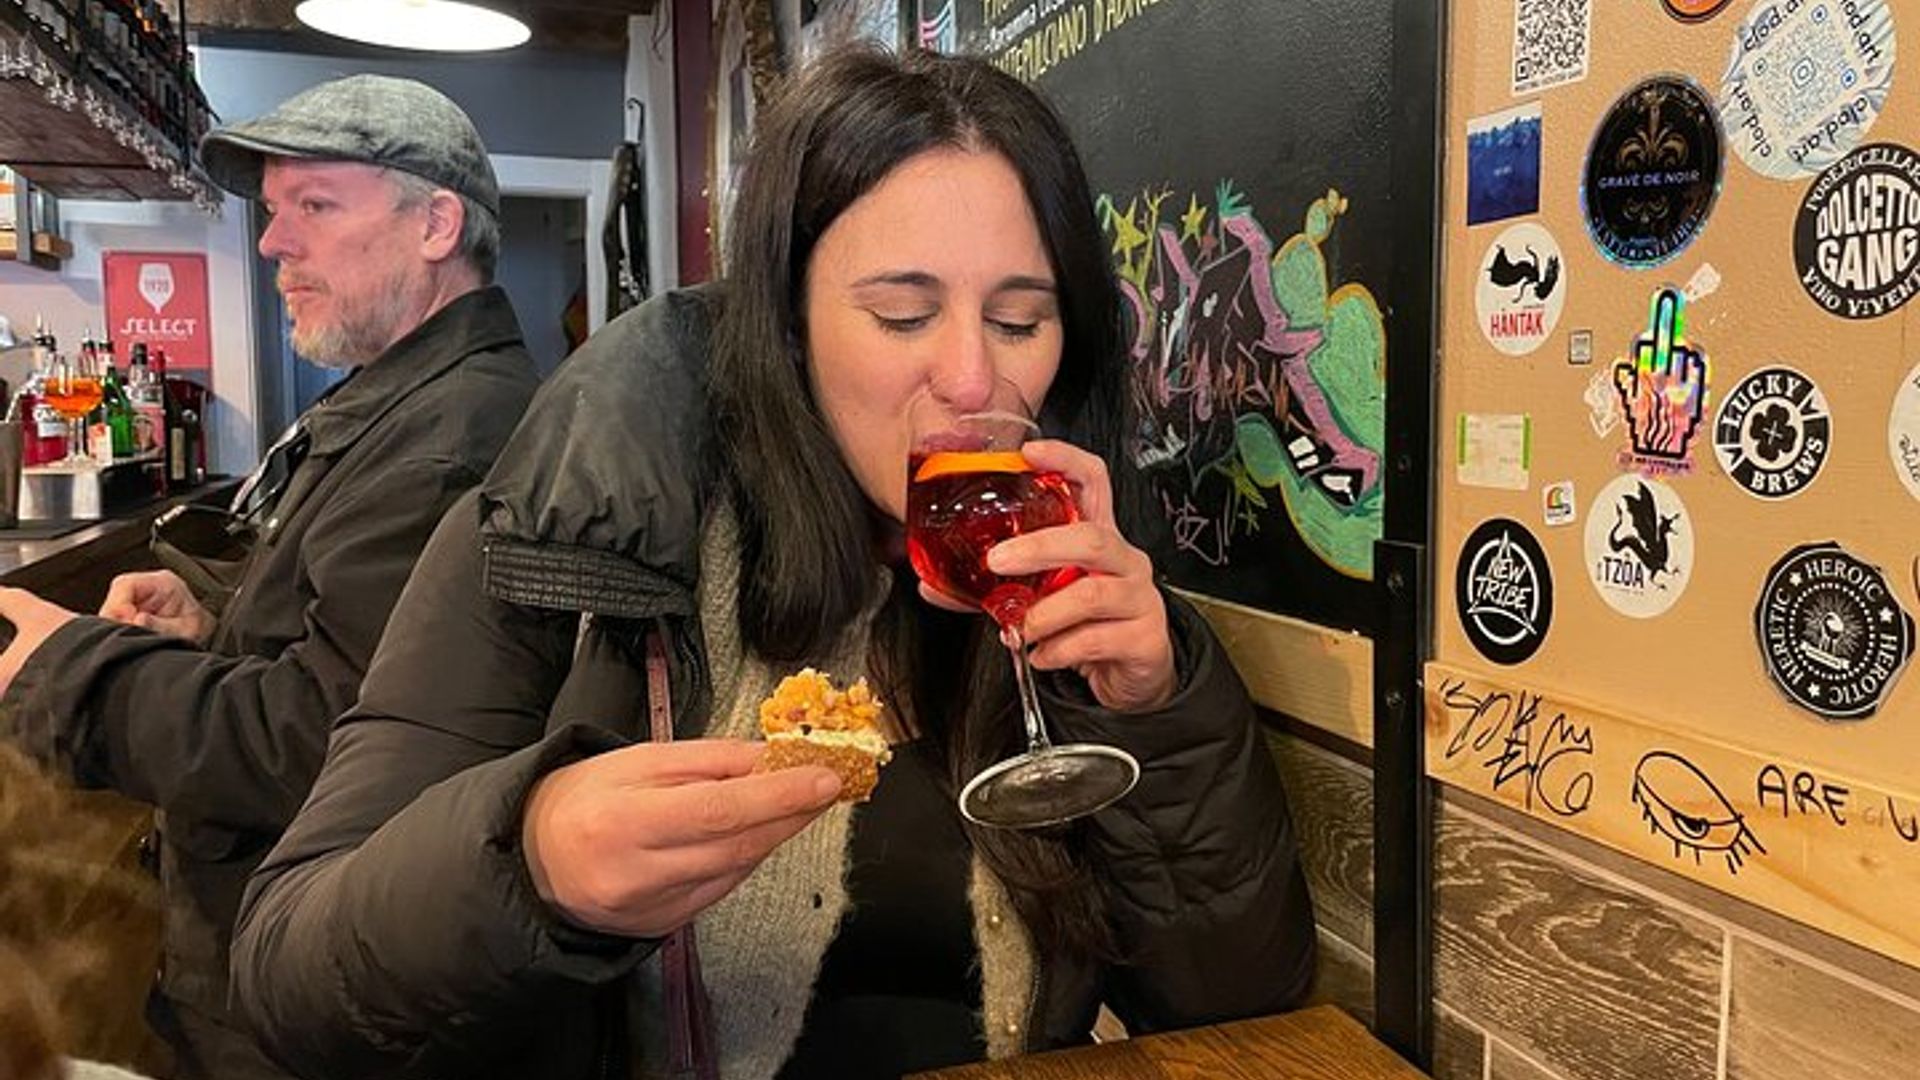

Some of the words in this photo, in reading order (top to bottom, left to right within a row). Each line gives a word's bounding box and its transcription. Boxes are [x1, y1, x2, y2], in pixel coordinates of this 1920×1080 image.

[1744, 0, 1803, 51] clod.a
[1731, 79, 1772, 158] clod.art
[1793, 97, 1868, 164] clod.art
[1664, 169, 1700, 185] NOIR
[1816, 173, 1920, 240] DOLCETTO
[1818, 228, 1918, 291] GANG
[120, 318, 197, 336] SELECT
[1722, 374, 1801, 428] LUCKY
[1751, 437, 1823, 493] BREWS
[1475, 575, 1532, 609] TRIBE
[1485, 553, 1527, 584] NEW
[1804, 558, 1884, 602] HEROIC
[1768, 587, 1805, 685] HERETIC
[1828, 632, 1898, 705] HEROTIC
[1757, 764, 1849, 826] ARE
